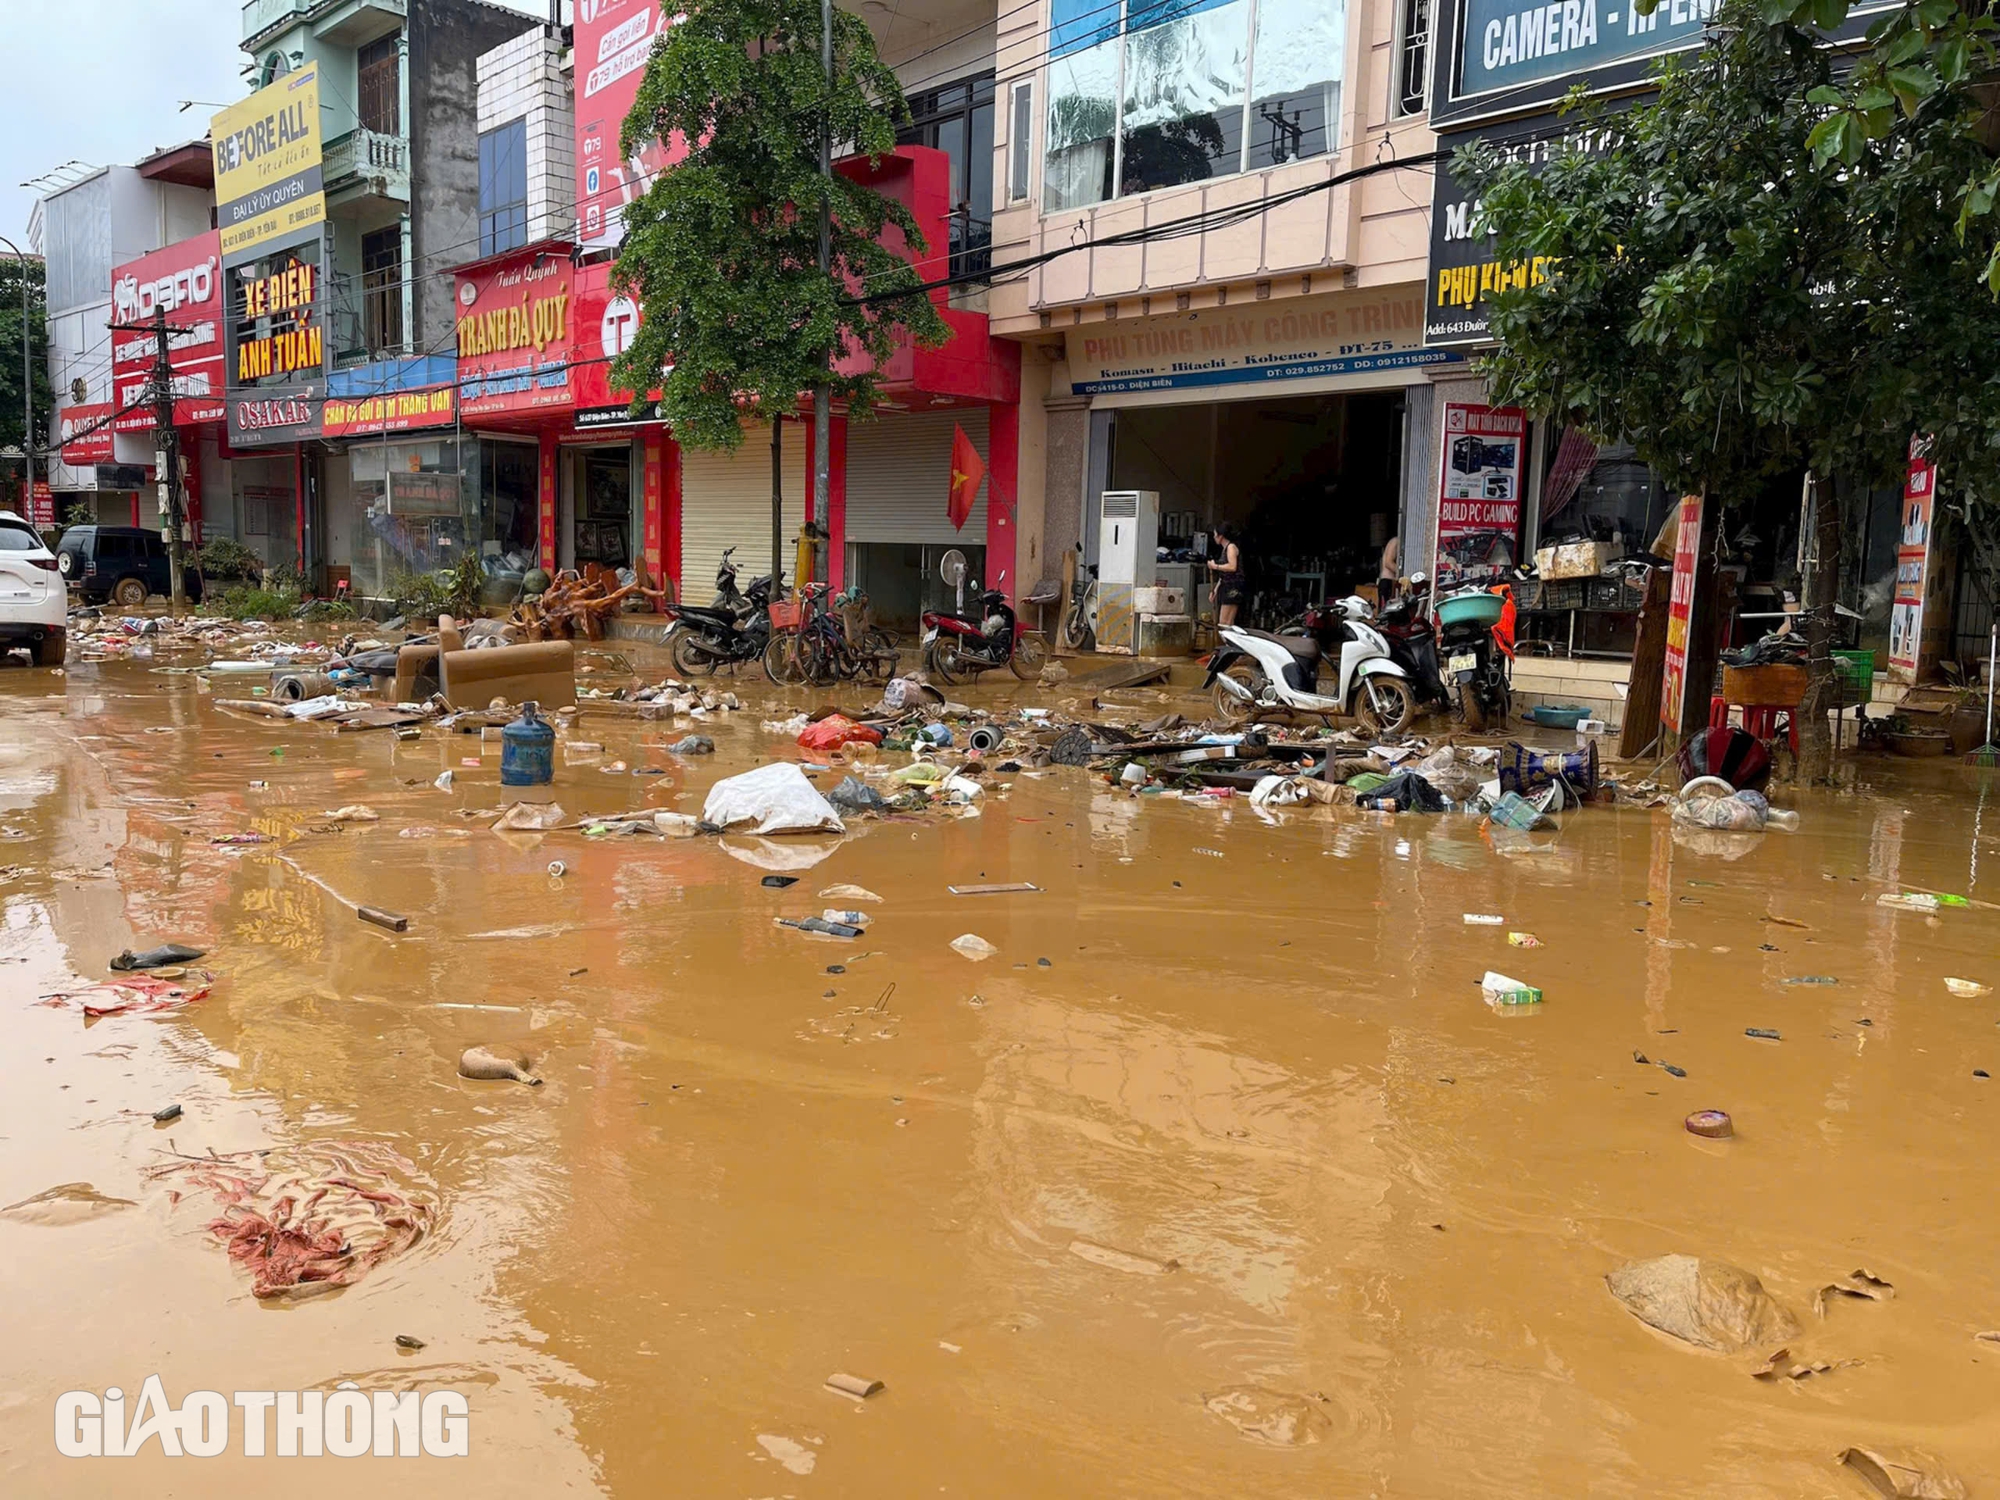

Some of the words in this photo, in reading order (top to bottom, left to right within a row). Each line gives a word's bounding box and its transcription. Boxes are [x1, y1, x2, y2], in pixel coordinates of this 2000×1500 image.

[1483, 0, 1598, 70] CAMERA
[217, 114, 276, 175] BEFORE
[279, 101, 309, 148] ALL
[244, 278, 266, 319] XE
[269, 258, 314, 319] ĐIỆN
[1438, 265, 1478, 310] PHỤ
[239, 337, 273, 381] ANH
[275, 310, 322, 373] TUẤN
[458, 307, 508, 357] TRANH
[510, 291, 531, 348] ĐÁ
[533, 281, 568, 352] QUÝ
[1200, 317, 1255, 350] MÁY
[1264, 309, 1338, 344] CÔNG
[1426, 322, 1446, 336] Add:
[1447, 321, 1463, 334] 643
[1171, 357, 1226, 373] Hitachi
[1442, 502, 1467, 521] BUILD
[1469, 503, 1482, 522] PC
[1483, 504, 1518, 524] GAMING
